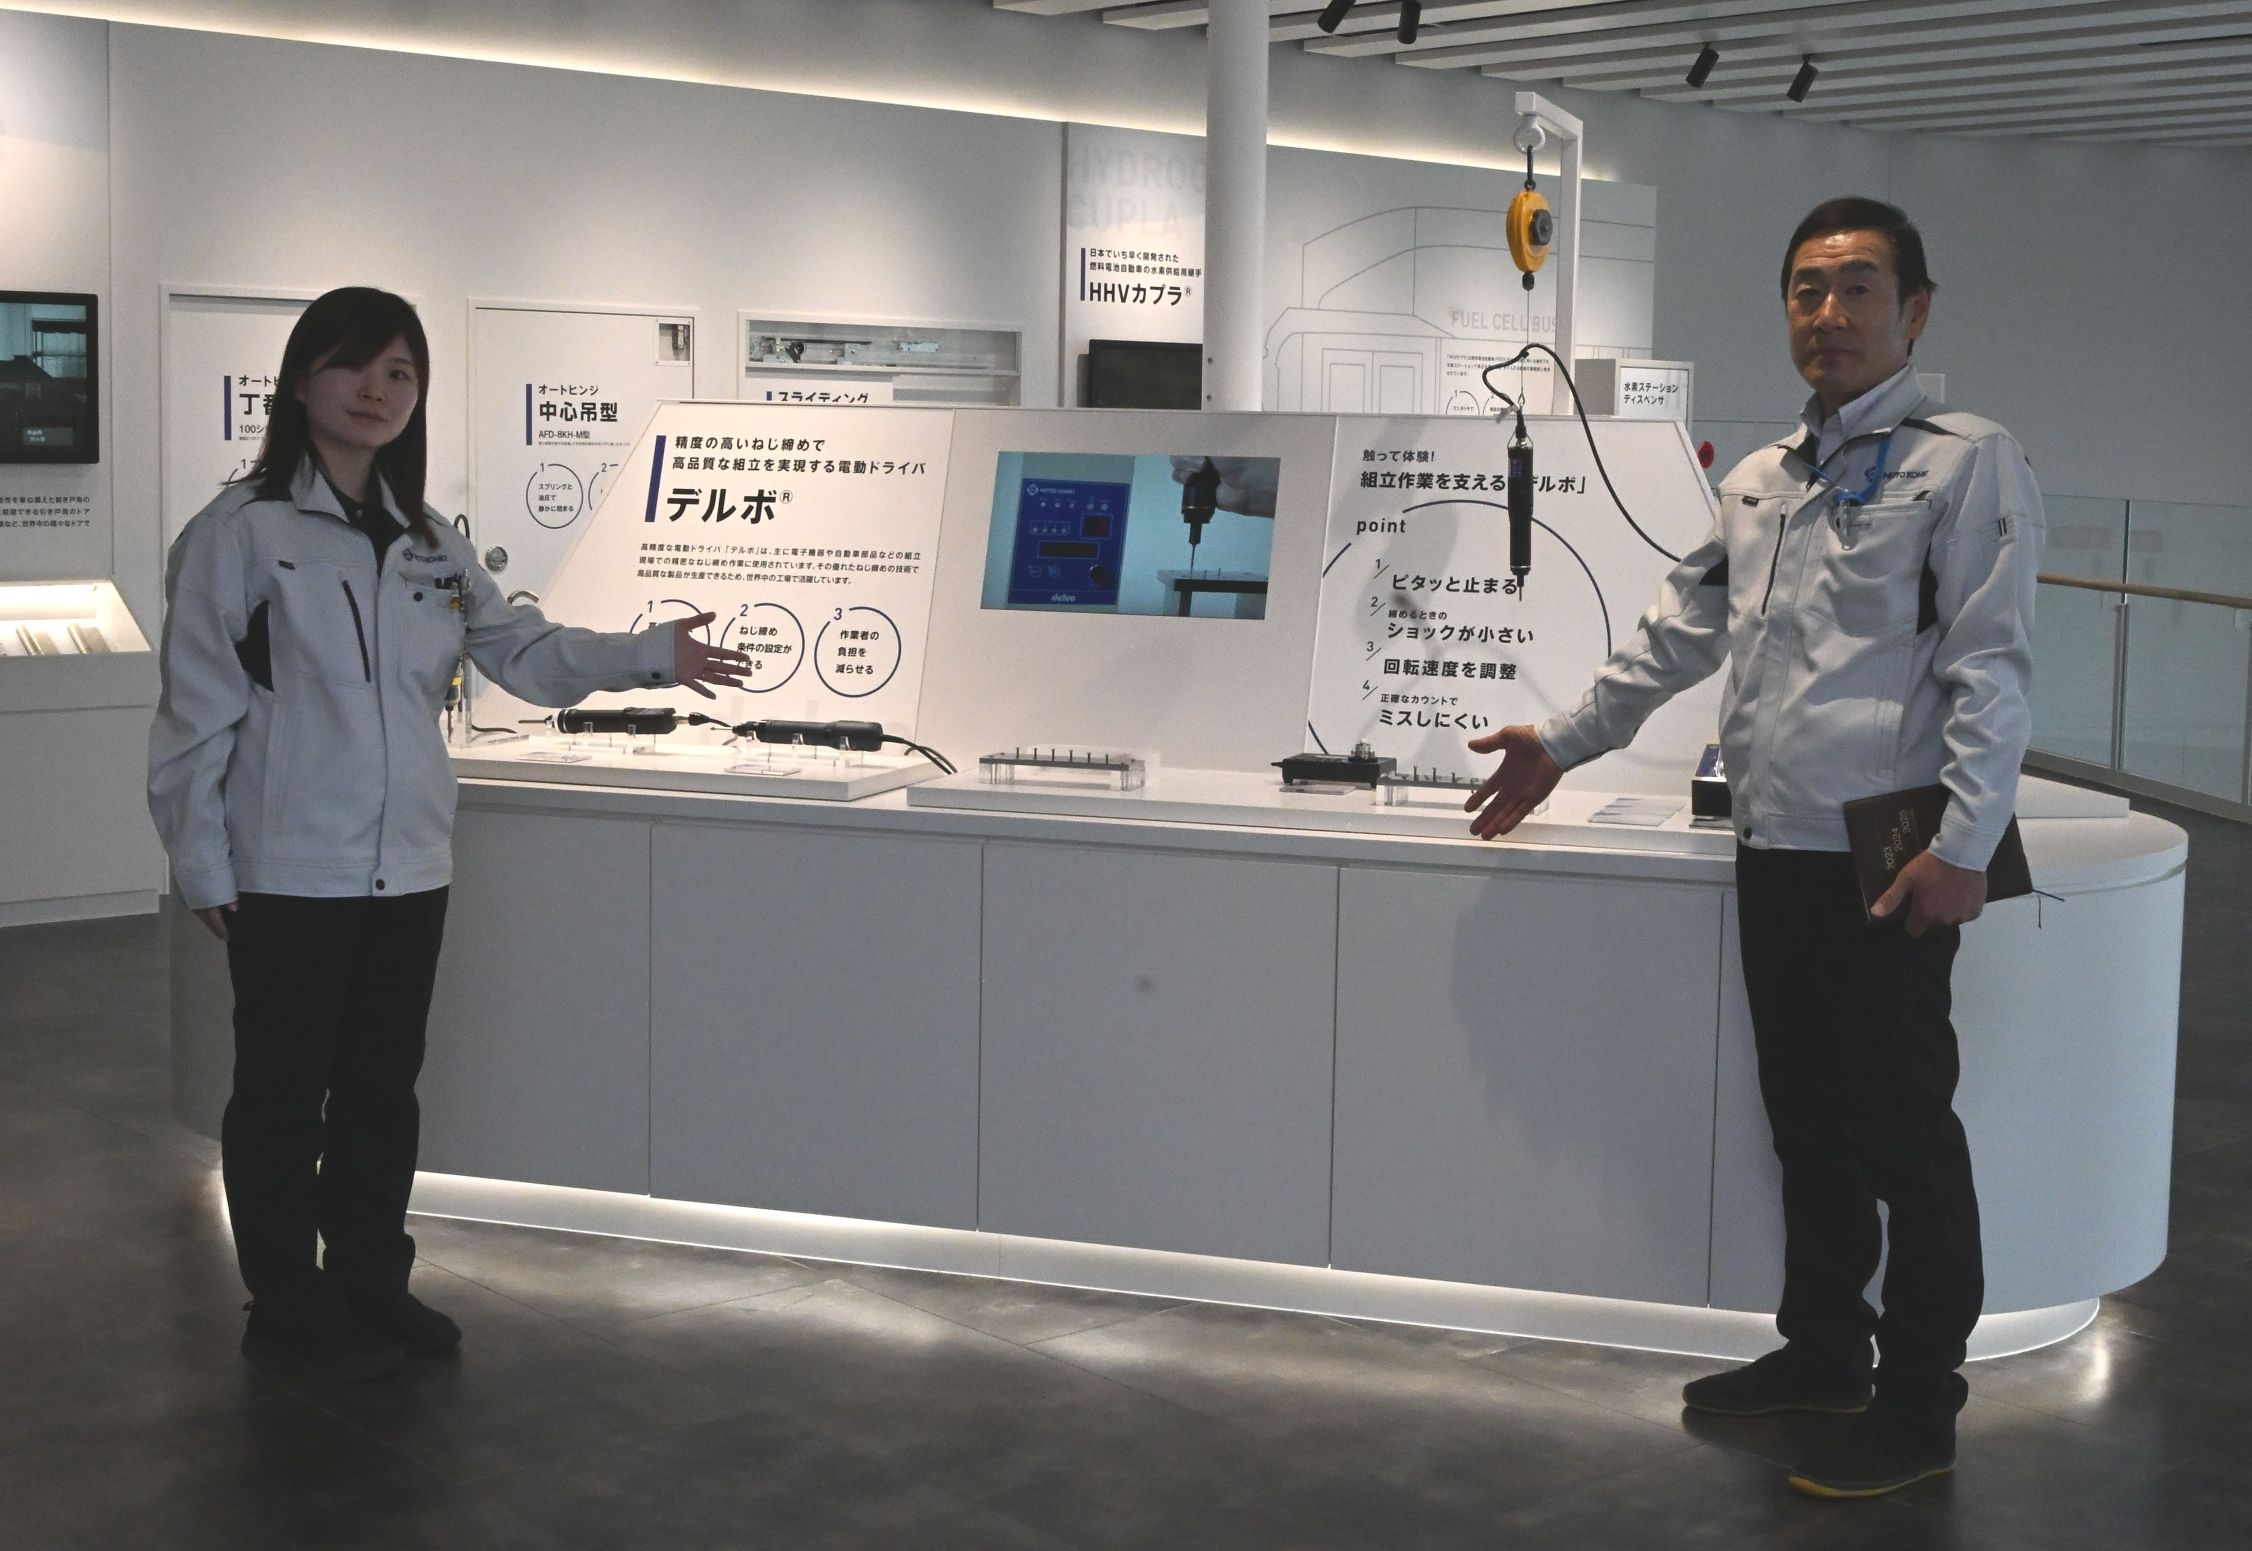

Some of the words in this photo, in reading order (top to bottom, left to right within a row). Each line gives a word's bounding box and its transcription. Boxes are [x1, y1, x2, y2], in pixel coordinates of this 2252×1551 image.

[1090, 248, 1179, 263] 日本でいち早く開発された
[1451, 311, 1488, 329] FUEL
[1493, 313, 1527, 331] CELL
[538, 384, 599, 396] オートヒンジ
[1624, 382, 1679, 394] 水素ステーション
[1624, 394, 1664, 405] ディスペンサ
[539, 401, 618, 422] 中心吊型
[675, 435, 826, 452] 精度の高いねじ締めで
[241, 459, 246, 469] 1
[539, 462, 545, 472] 1
[601, 462, 607, 473] 2
[672, 456, 926, 476] 高品質な組立を実現する電動ドライバ
[1360, 471, 1586, 494] 組立作業を支えるルボ」
[1356, 518, 1407, 535] point
[1392, 574, 1518, 595] ピタッと止まる
[647, 600, 654, 613] 1
[739, 604, 749, 617] 2
[833, 607, 843, 621] 3
[1388, 609, 1448, 620] 締めるときの
[739, 625, 778, 637] ねじ締め
[840, 630, 879, 641] 作業者の
[1387, 622, 1534, 644] ショックが小さい
[737, 642, 793, 654] 条件の設定が
[837, 647, 867, 658] 負担を
[835, 664, 874, 675] 減らせる
[1383, 658, 1517, 681] 回転速度を調整
[1380, 693, 1459, 706] 正確なカウントで
[1379, 709, 1489, 730] ミスしにくい
